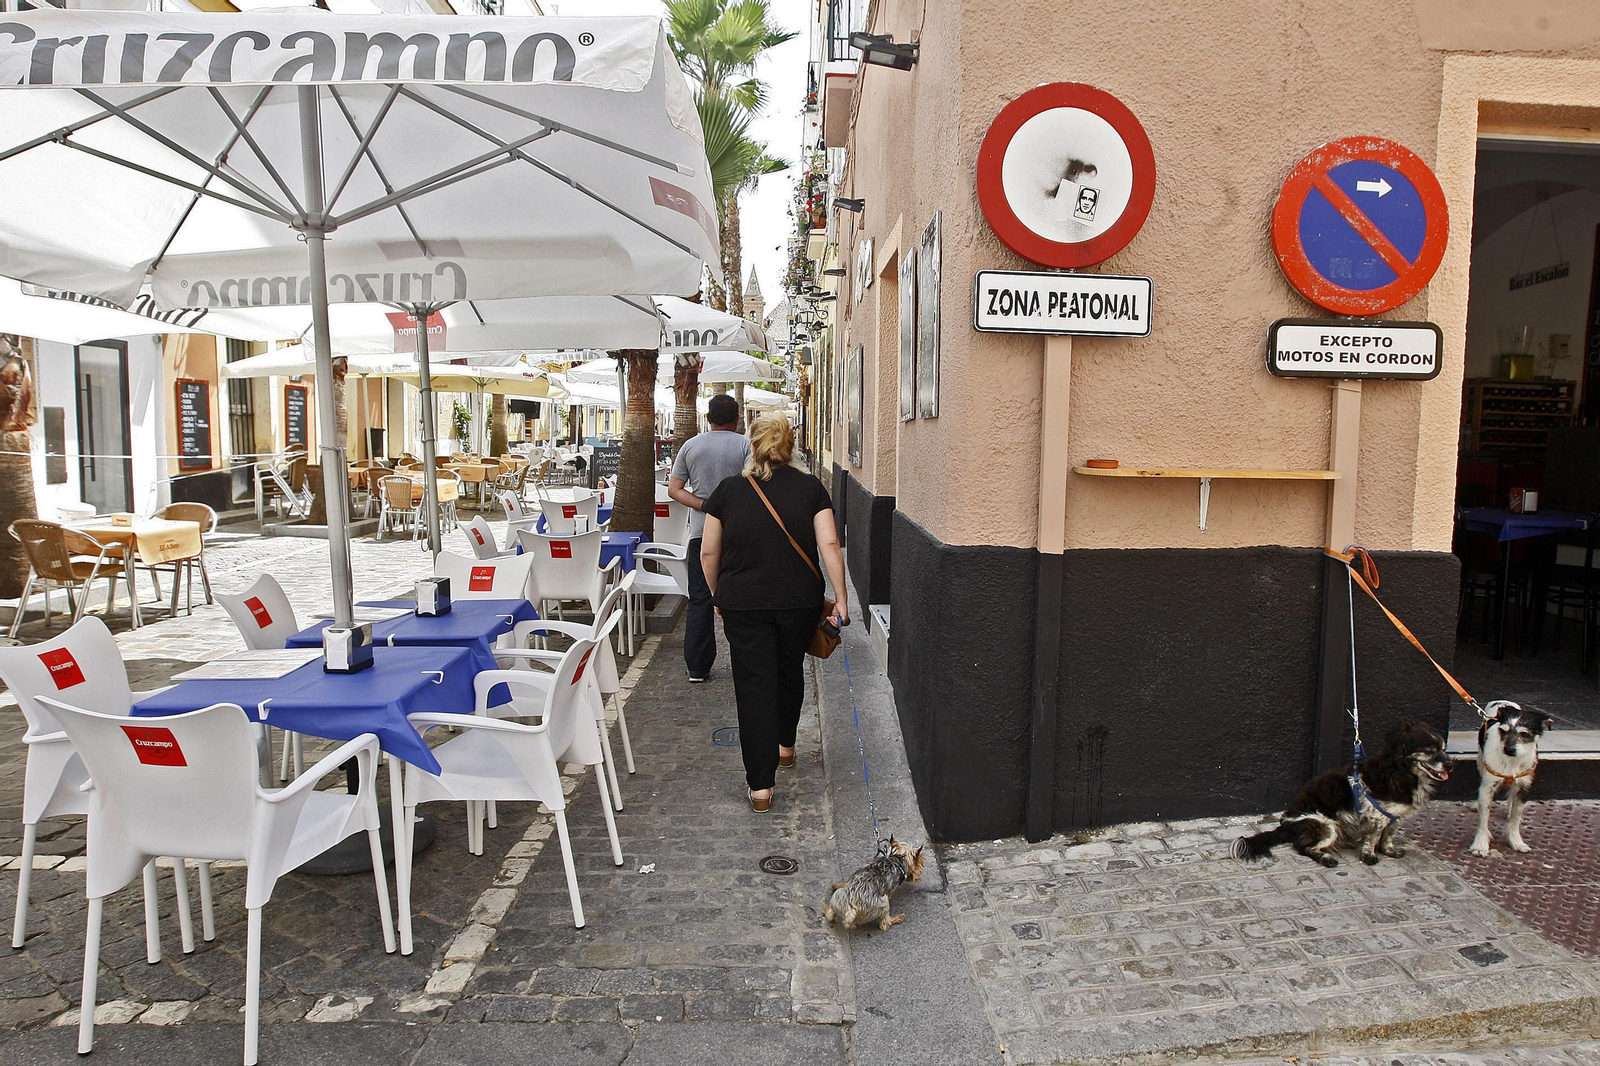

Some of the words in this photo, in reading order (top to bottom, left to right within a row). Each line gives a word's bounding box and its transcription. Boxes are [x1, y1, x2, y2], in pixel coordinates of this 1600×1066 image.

[1509, 278, 1523, 291] Bar
[1525, 273, 1533, 287] el
[987, 289, 1041, 317] ZONA
[1048, 291, 1139, 321] PEATONAL
[1320, 335, 1393, 348] EXCEPTO
[1278, 350, 1334, 363] MOTOS
[1339, 352, 1360, 364] EN
[1366, 353, 1433, 366] CORDON
[50, 660, 74, 672] Cruzcampo
[135, 739, 173, 749] Cruzcampo
